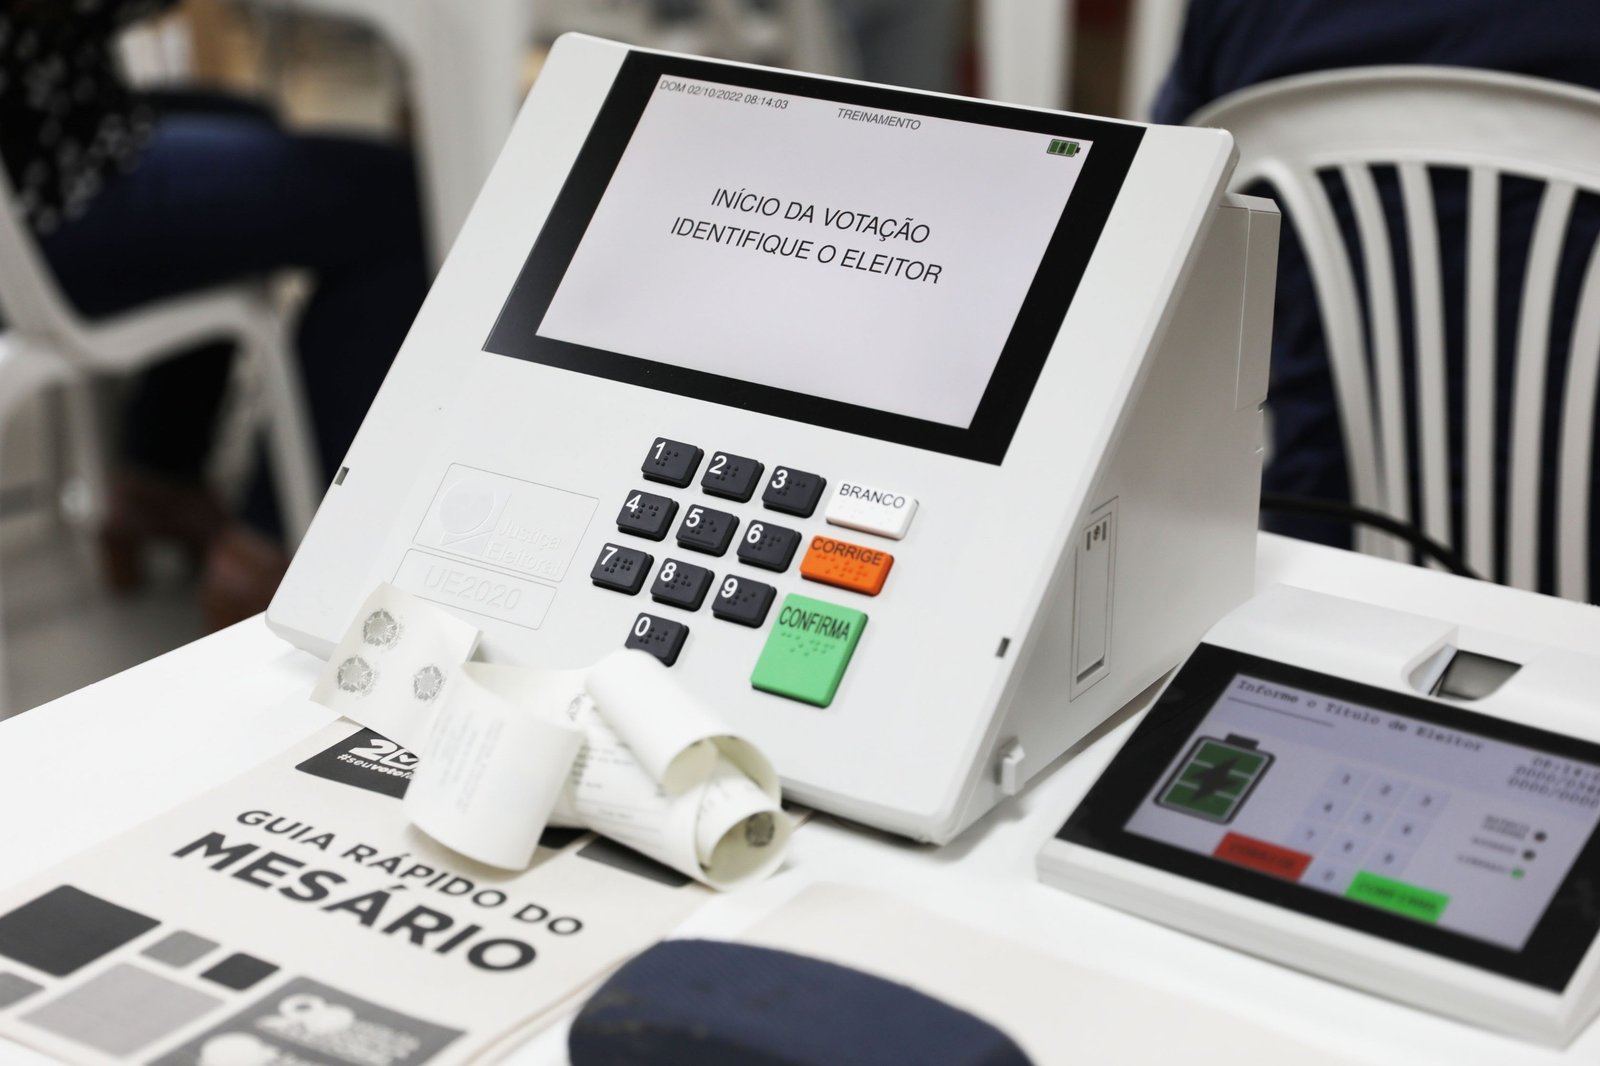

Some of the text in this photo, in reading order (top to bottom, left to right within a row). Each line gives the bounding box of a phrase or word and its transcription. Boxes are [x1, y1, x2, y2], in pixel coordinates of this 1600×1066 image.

[659, 80, 789, 110] DOM 02/10/2022 08:14:03
[837, 107, 921, 131] TREINAMENTO
[711, 187, 931, 244] INÍCIO DA VOTAÇÃO
[670, 216, 943, 285] IDENTIFIQUE O ELEITOR
[654, 441, 666, 460] 1
[708, 455, 727, 475] 2
[771, 469, 788, 489] 3
[625, 494, 643, 513] 4
[839, 483, 906, 510] BRANCO
[685, 508, 704, 528] 5
[746, 523, 764, 544] 6
[600, 546, 619, 566] 7
[811, 537, 884, 567] CORRIGE
[660, 562, 677, 582] 8
[423, 565, 522, 610] UE2020
[721, 578, 738, 598] 9
[634, 617, 651, 637] 0
[779, 605, 851, 641] CONFIRMA
[235, 809, 584, 937] GUIA RÁPIDO DO
[171, 831, 539, 974] MESÁRIO
